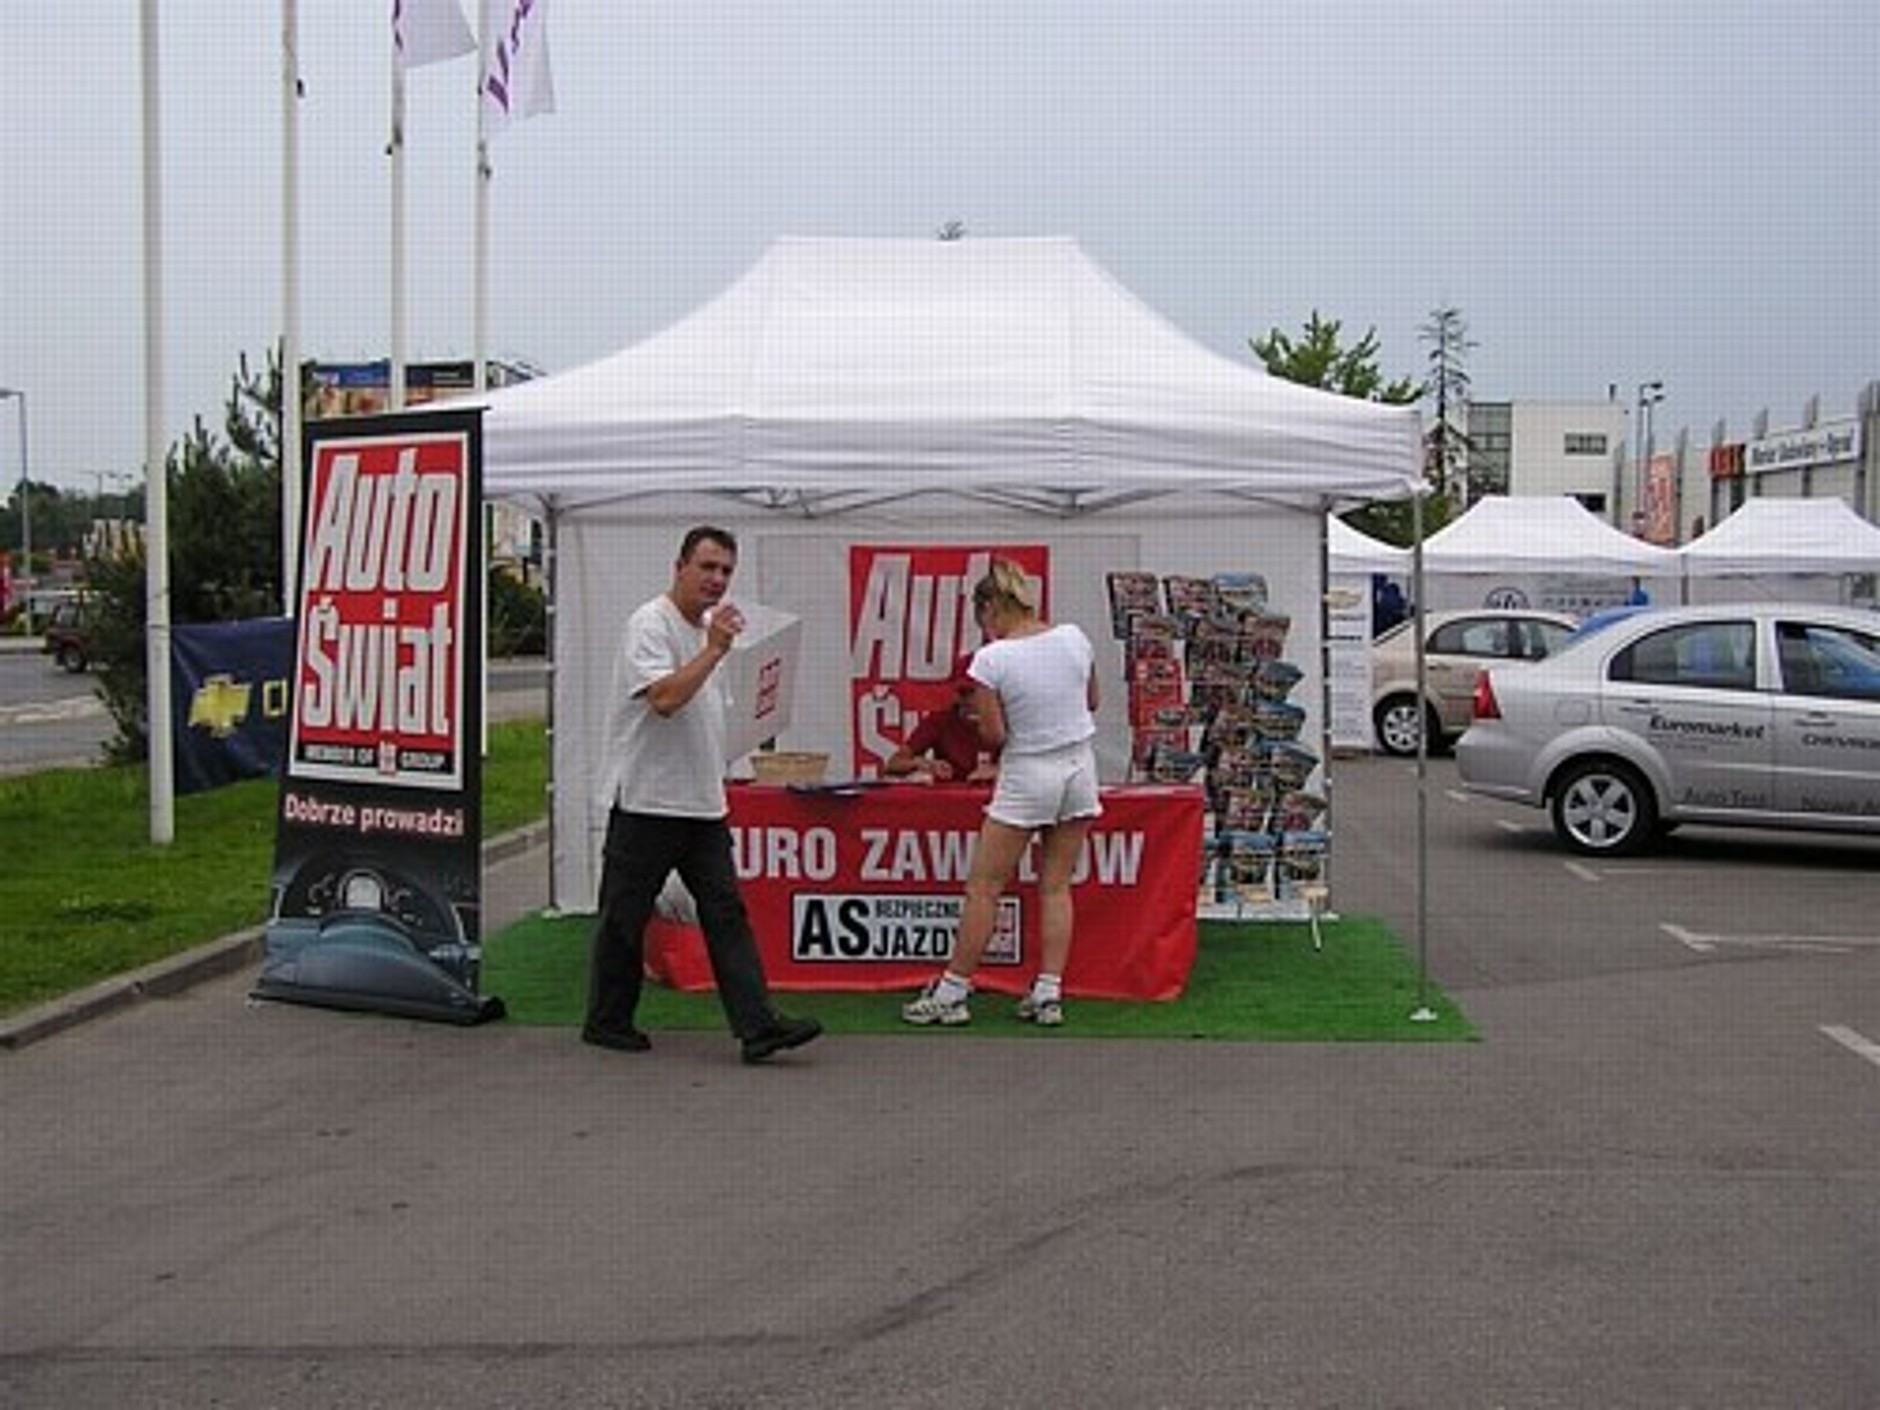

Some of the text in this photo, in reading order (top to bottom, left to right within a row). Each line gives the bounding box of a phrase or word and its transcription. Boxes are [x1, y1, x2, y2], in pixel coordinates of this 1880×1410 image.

[304, 448, 457, 592] Auto
[303, 596, 453, 736] Świat
[1650, 714, 1765, 739] Euromarket
[285, 793, 464, 836] Dobrze prowadzi
[797, 898, 870, 956] AS
[873, 925, 957, 957] JAZD
